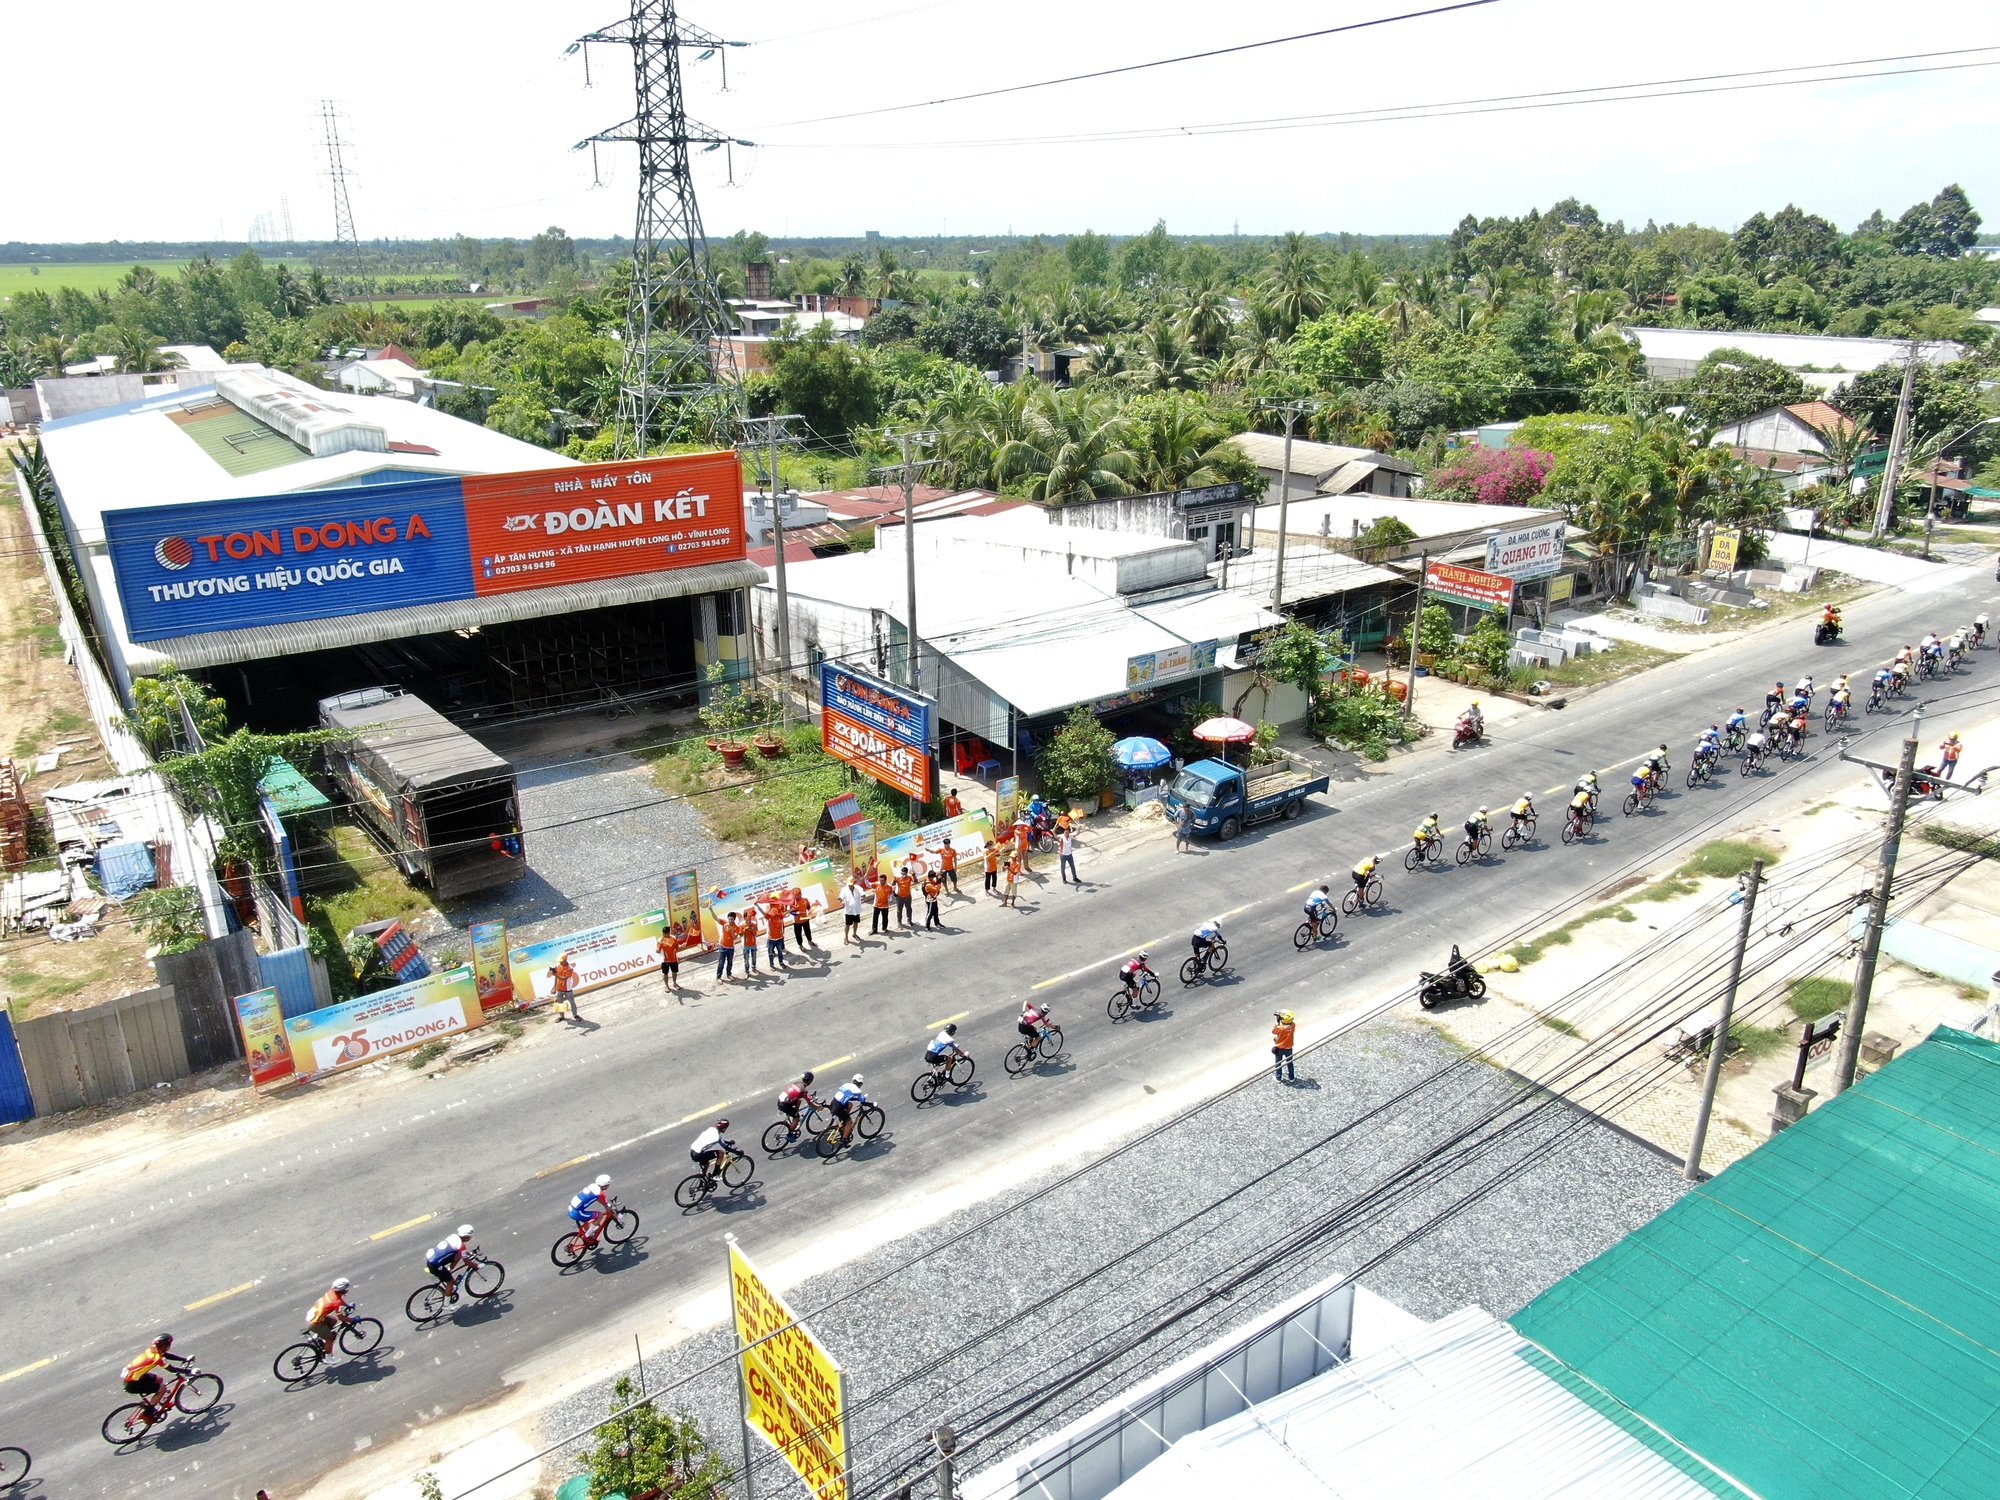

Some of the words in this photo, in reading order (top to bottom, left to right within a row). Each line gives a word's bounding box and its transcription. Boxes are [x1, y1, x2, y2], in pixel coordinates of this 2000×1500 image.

[554, 478, 584, 493] NHÀ
[590, 474, 618, 489] MÁY
[626, 471, 652, 485] TÔN
[544, 498, 644, 535] ĐOÀN
[653, 488, 710, 522] KẾT
[197, 530, 282, 561] TON
[293, 517, 397, 552] DONG
[405, 514, 431, 540] A
[508, 552, 526, 562] TÂN
[528, 549, 555, 560] HƯNG
[560, 546, 573, 555] XÃ
[574, 543, 591, 553] TÂN
[648, 534, 670, 544] LONG
[688, 529, 708, 539] VĨNH
[709, 527, 730, 537] LONG
[678, 540, 700, 551] 02703
[1715, 550, 1731, 560] HOA
[495, 565, 521, 575] 02703
[1502, 545, 1536, 566] QUANG
[148, 573, 250, 602] THƯƠNG
[256, 567, 302, 591] HIỆU
[306, 558, 365, 586] QUỐC
[368, 557, 405, 575] GIA
[1437, 567, 1467, 582] THÀNH
[1468, 573, 1502, 589] NGHIỆP
[850, 729, 887, 761] ĐOÀN
[581, 968, 608, 984] TON
[609, 958, 641, 976] DONG
[640, 953, 656, 966] A
[331, 1028, 371, 1065] 25
[371, 1032, 404, 1051] TON
[405, 1019, 446, 1041] DONG
[447, 1016, 459, 1028] A
[735, 1272, 760, 1318] TÂN
[764, 1308, 790, 1355] CÂY
[795, 1344, 836, 1412] BÀNG
[763, 1349, 787, 1387] 0918
[783, 1356, 807, 1396] CƠM
